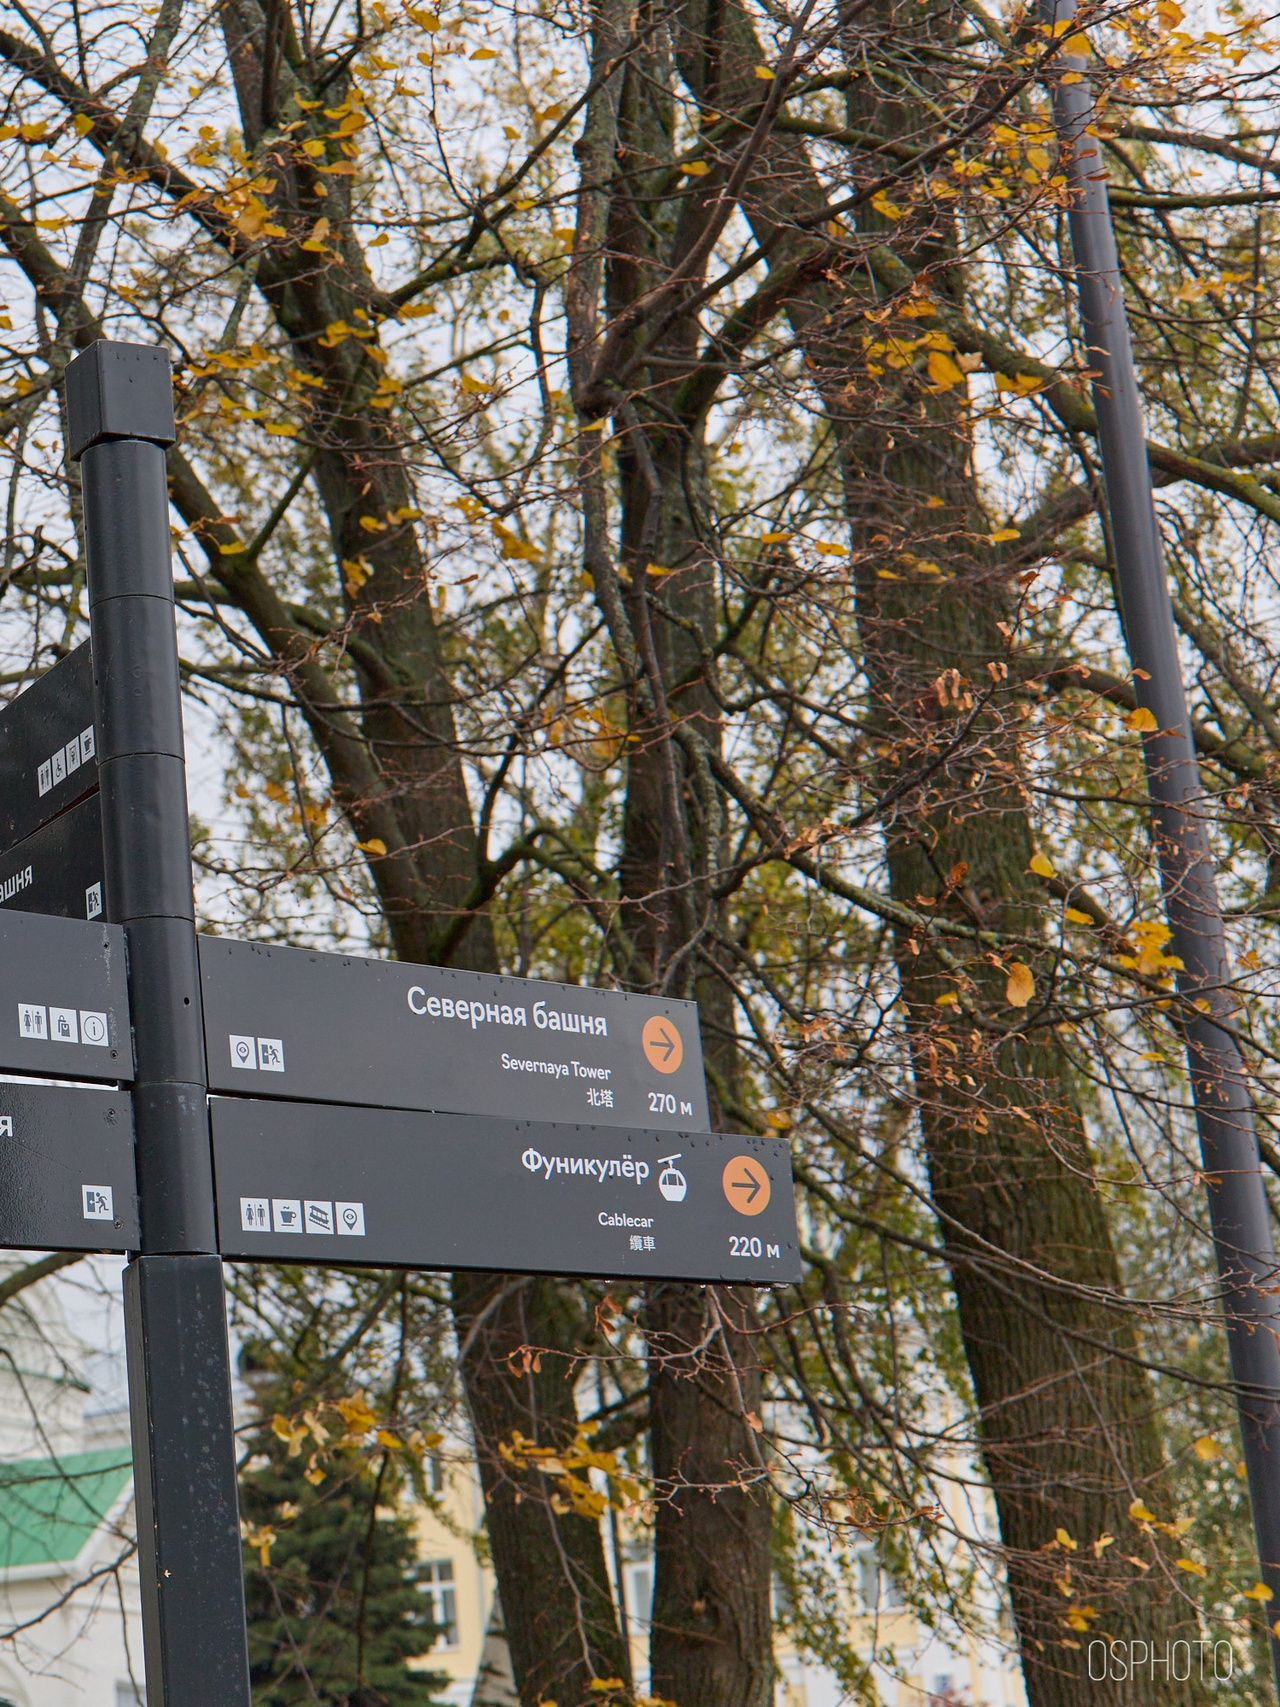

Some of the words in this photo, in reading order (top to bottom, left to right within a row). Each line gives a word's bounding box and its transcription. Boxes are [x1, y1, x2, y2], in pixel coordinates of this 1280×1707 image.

[408, 986, 526, 1029] Северная
[533, 1001, 607, 1036] башня
[502, 1053, 569, 1079] Severnaya
[571, 1061, 611, 1080] Tower
[587, 1088, 613, 1108] 北塔
[648, 1092, 676, 1113] 270
[680, 1102, 692, 1115] м
[522, 1148, 648, 1184] Фуникулёр
[599, 1212, 653, 1227] Cablecar
[729, 1236, 761, 1257] 220
[767, 1244, 779, 1258] м
